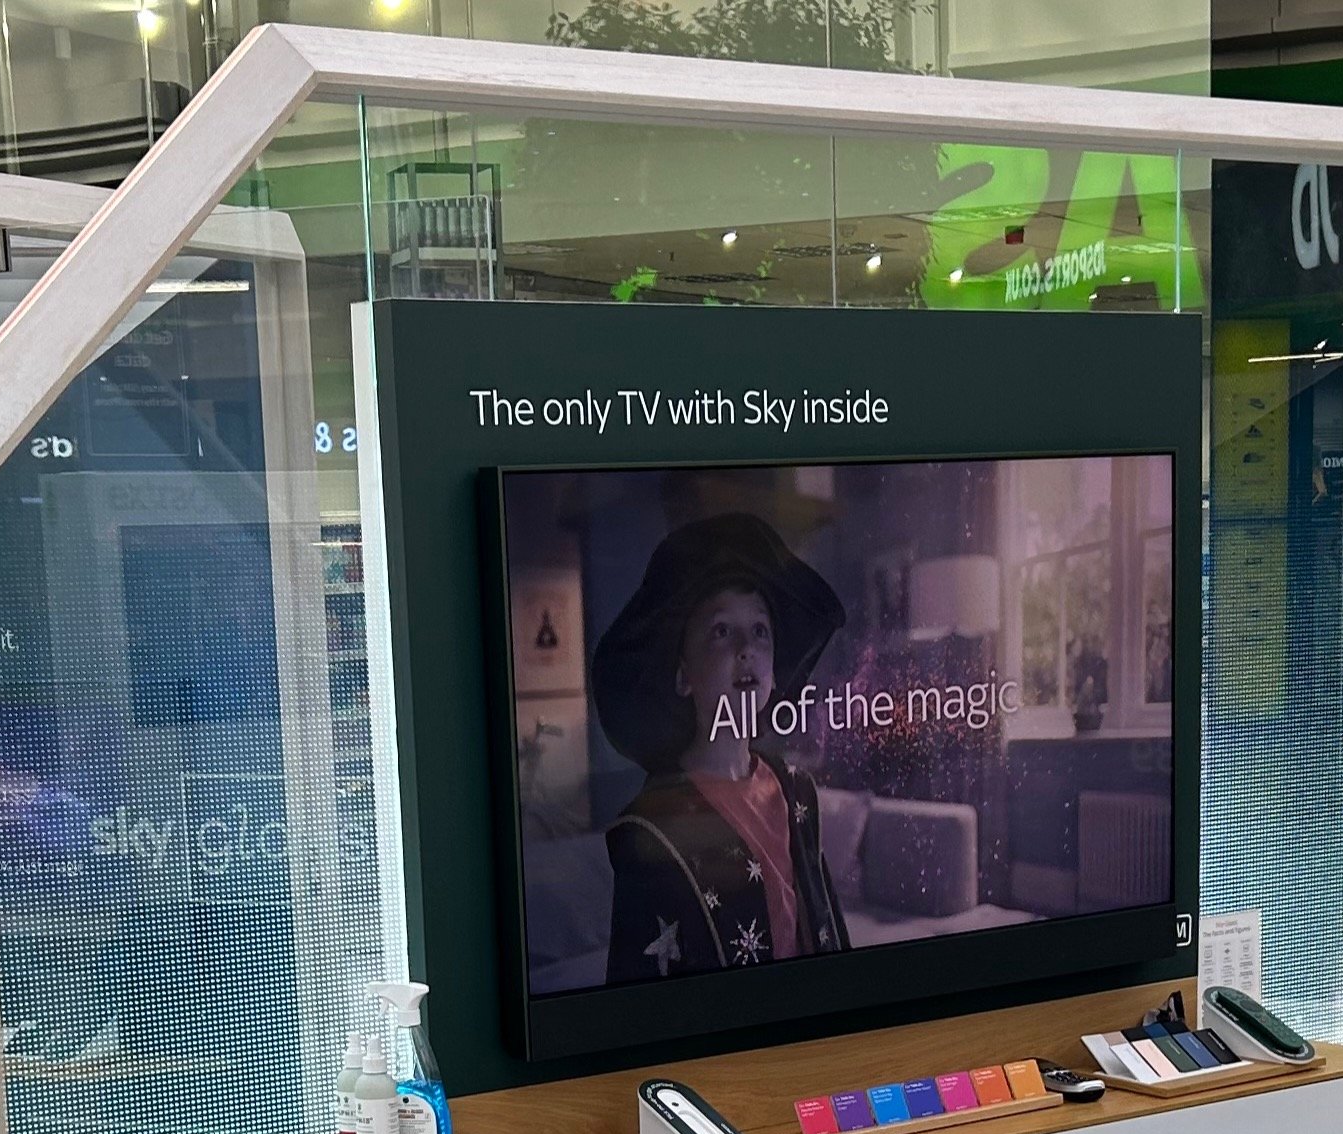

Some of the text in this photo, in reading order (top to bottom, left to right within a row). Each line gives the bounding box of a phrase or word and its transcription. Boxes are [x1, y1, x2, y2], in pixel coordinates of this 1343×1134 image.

[470, 389, 889, 434] The only TV with Sky inside
[709, 669, 1022, 742] All of the magic
[90, 803, 174, 870] sky
